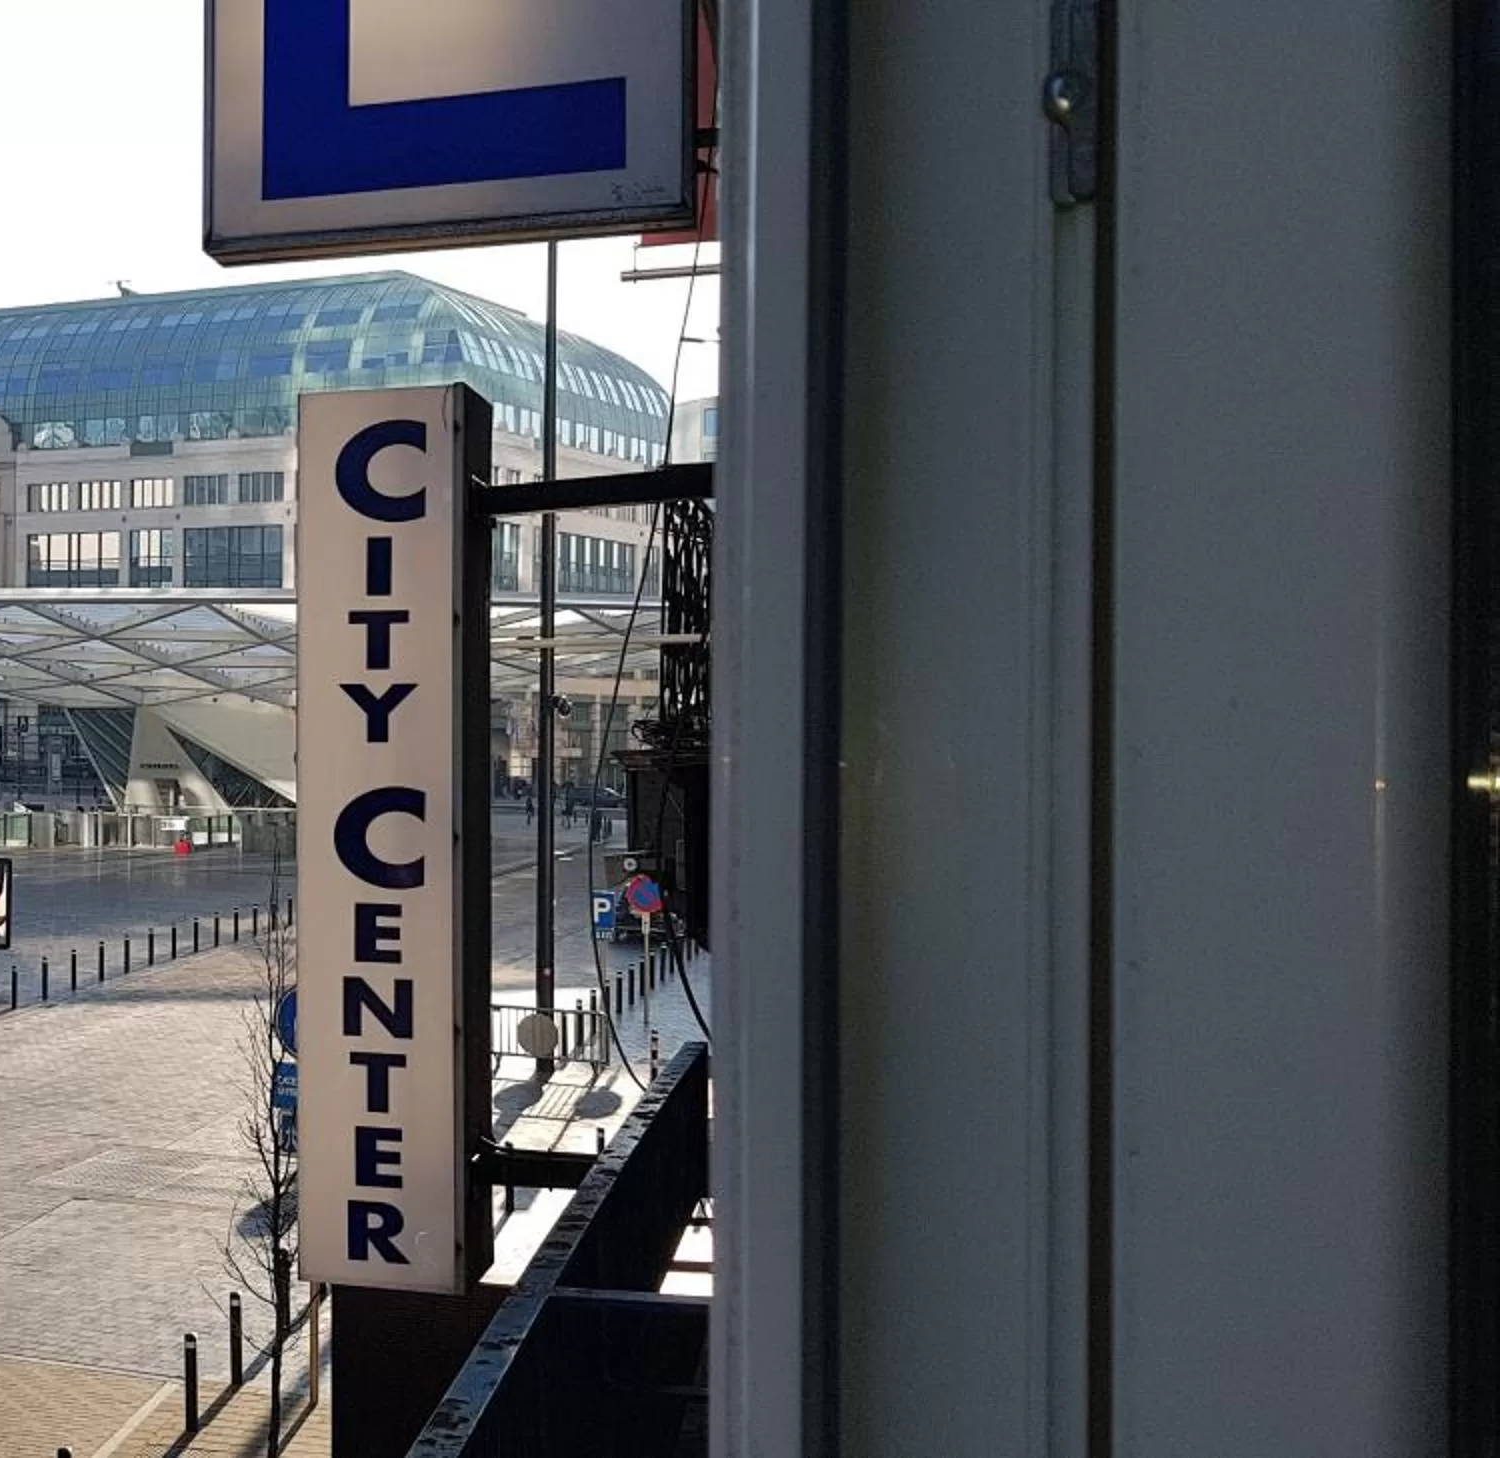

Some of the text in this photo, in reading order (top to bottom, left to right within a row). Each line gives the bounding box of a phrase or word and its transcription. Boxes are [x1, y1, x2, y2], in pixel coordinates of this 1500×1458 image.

[334, 420, 427, 1266] CITY CENTER
[593, 898, 611, 924] P
